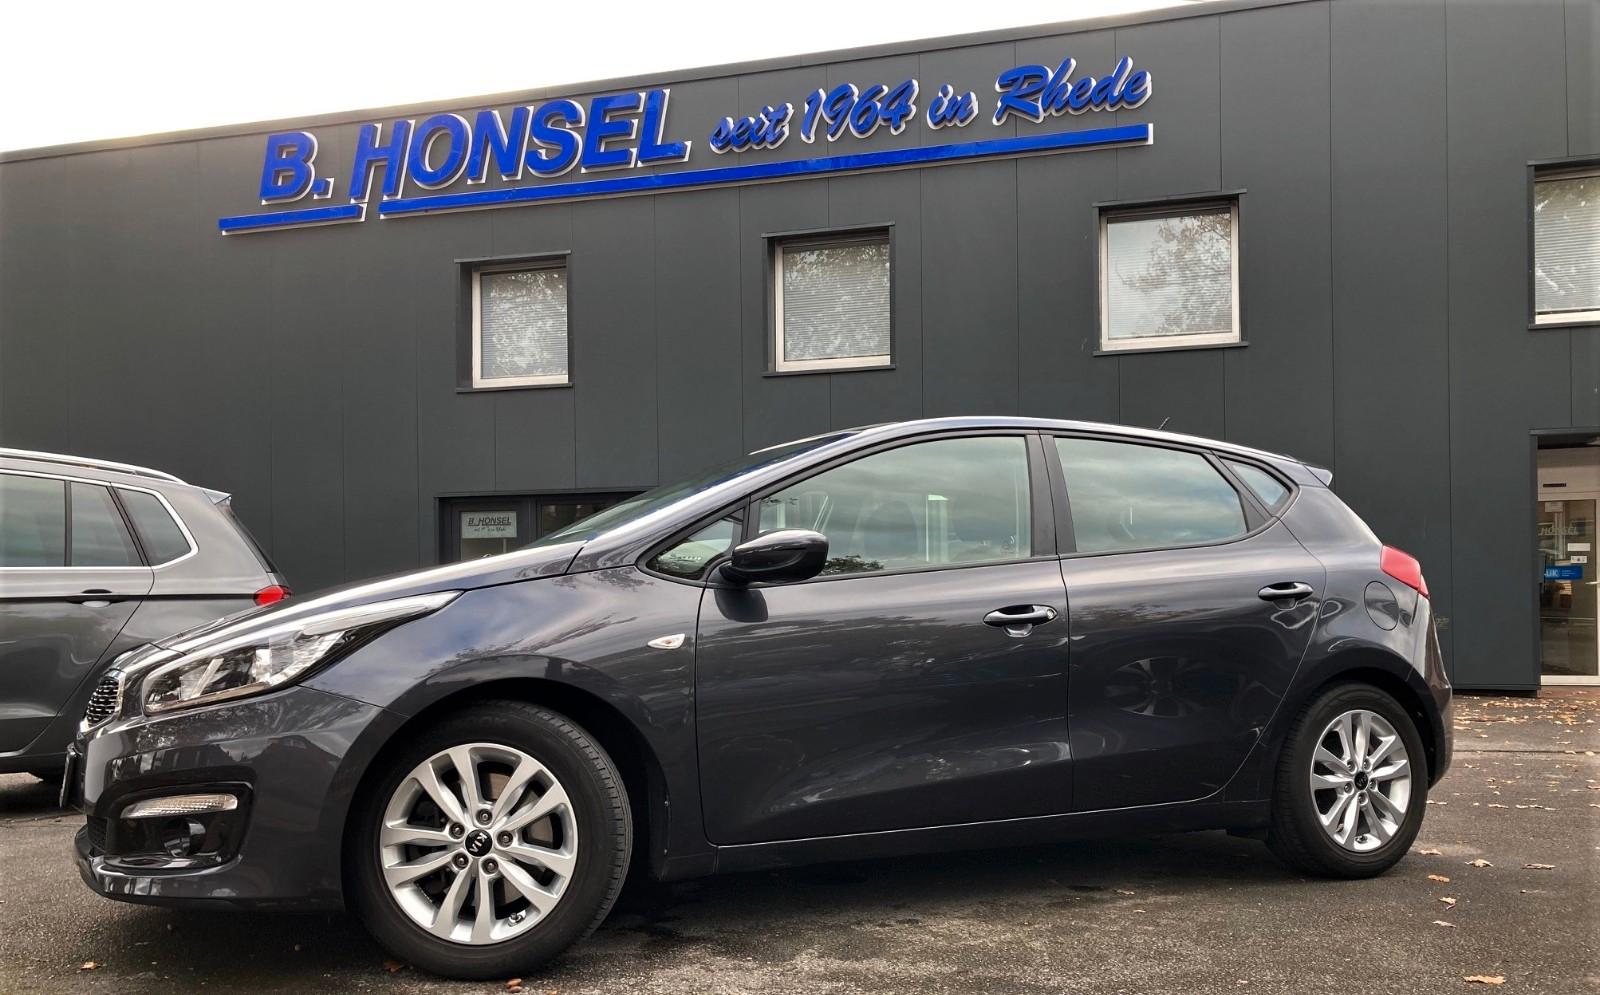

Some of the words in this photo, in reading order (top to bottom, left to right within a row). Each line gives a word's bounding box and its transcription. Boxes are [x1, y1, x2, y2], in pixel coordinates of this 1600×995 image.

[259, 131, 334, 205] B.
[349, 88, 692, 204] HONSEL
[708, 102, 793, 154] seit
[800, 78, 919, 143] 1964
[926, 84, 979, 130] in
[992, 56, 1153, 125] Rhede
[478, 516, 512, 525] HONSEL
